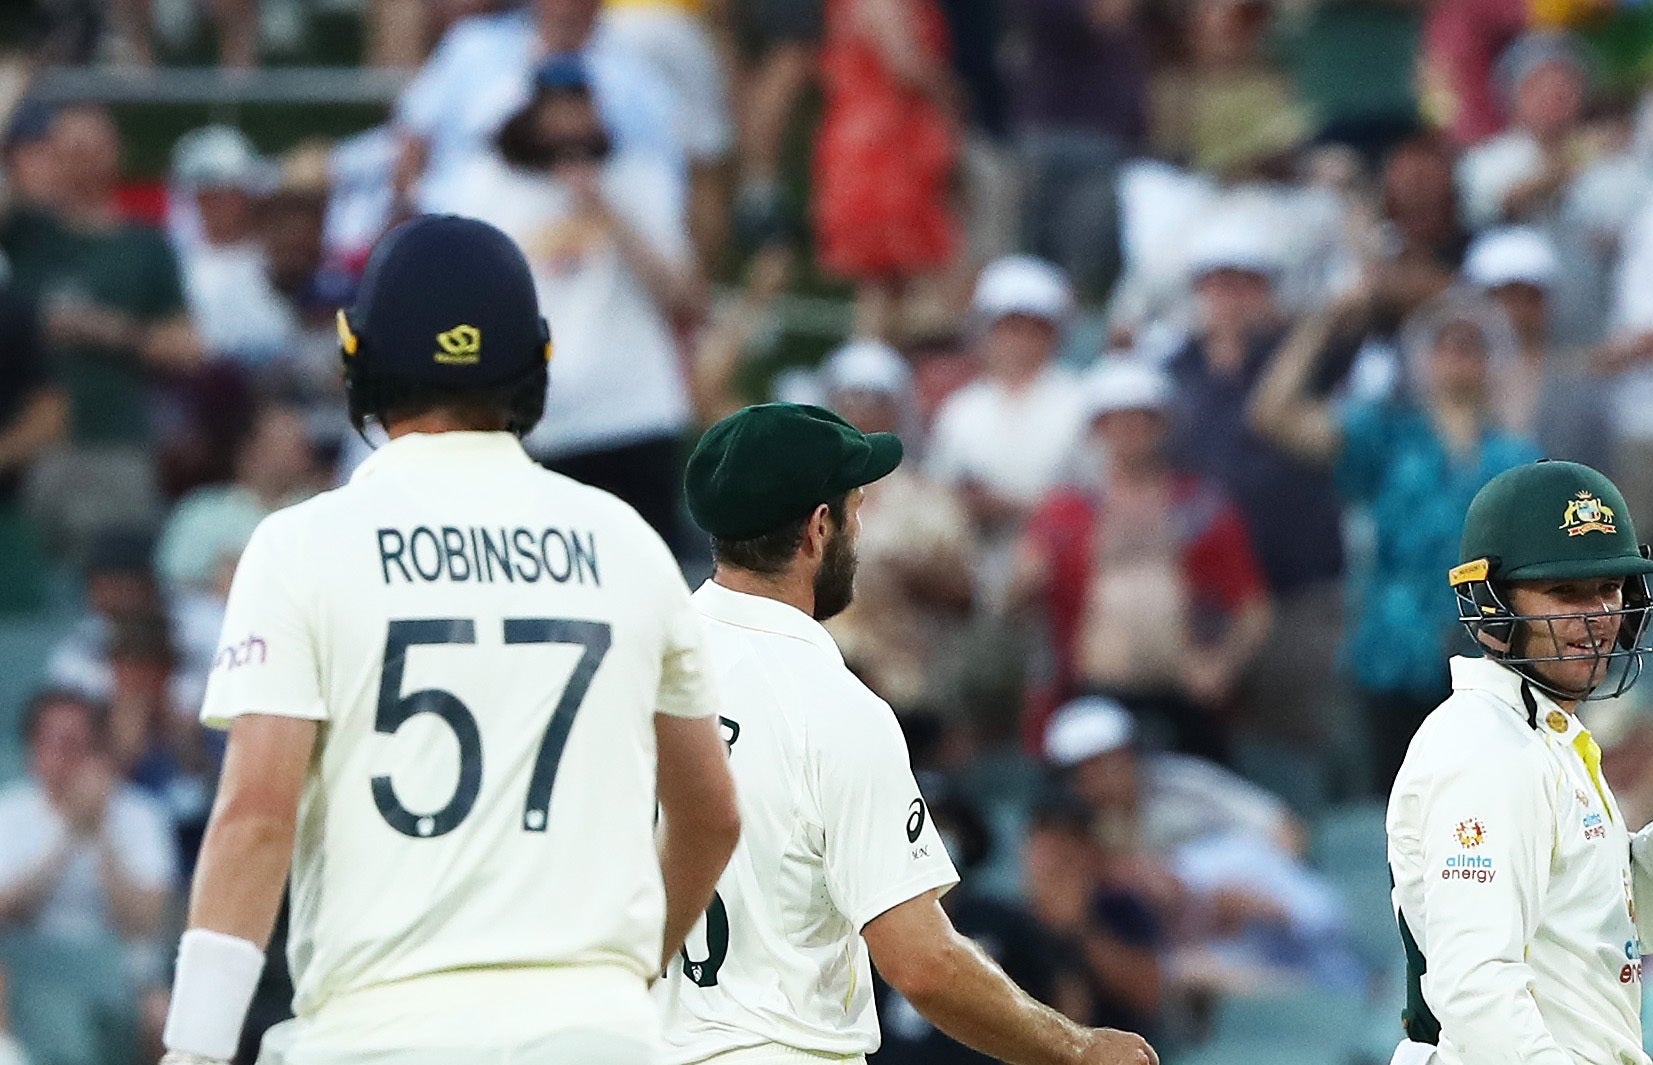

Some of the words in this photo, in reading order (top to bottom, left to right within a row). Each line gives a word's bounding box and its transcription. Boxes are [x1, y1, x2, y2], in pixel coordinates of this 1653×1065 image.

[377, 526, 599, 586] ROBINSON
[371, 618, 612, 838] 57
[1442, 869, 1497, 883] energy
[1446, 855, 1492, 868] alinta
